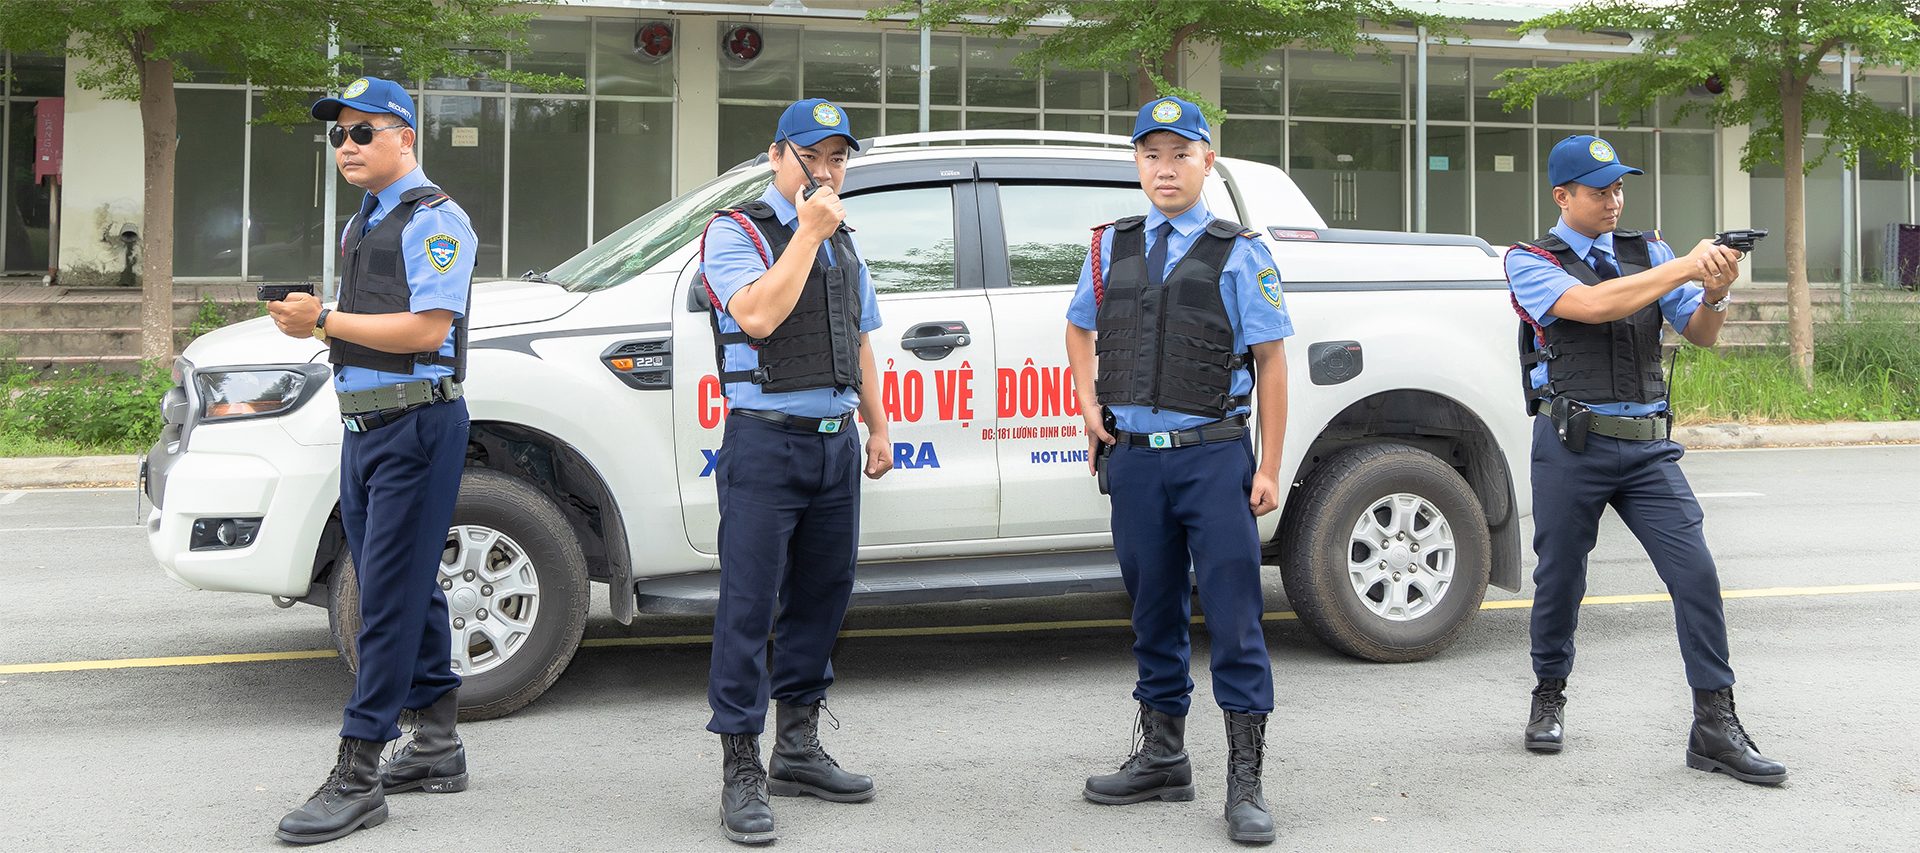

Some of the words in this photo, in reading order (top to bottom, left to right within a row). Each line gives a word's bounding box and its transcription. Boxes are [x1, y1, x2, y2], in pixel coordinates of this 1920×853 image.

[387, 101, 412, 120] SECURITY
[858, 358, 924, 423] ẢO
[934, 360, 974, 428] VỆ
[997, 357, 1083, 419] ĐÔNG
[997, 427, 1011, 440] 181
[890, 441, 941, 470] RA
